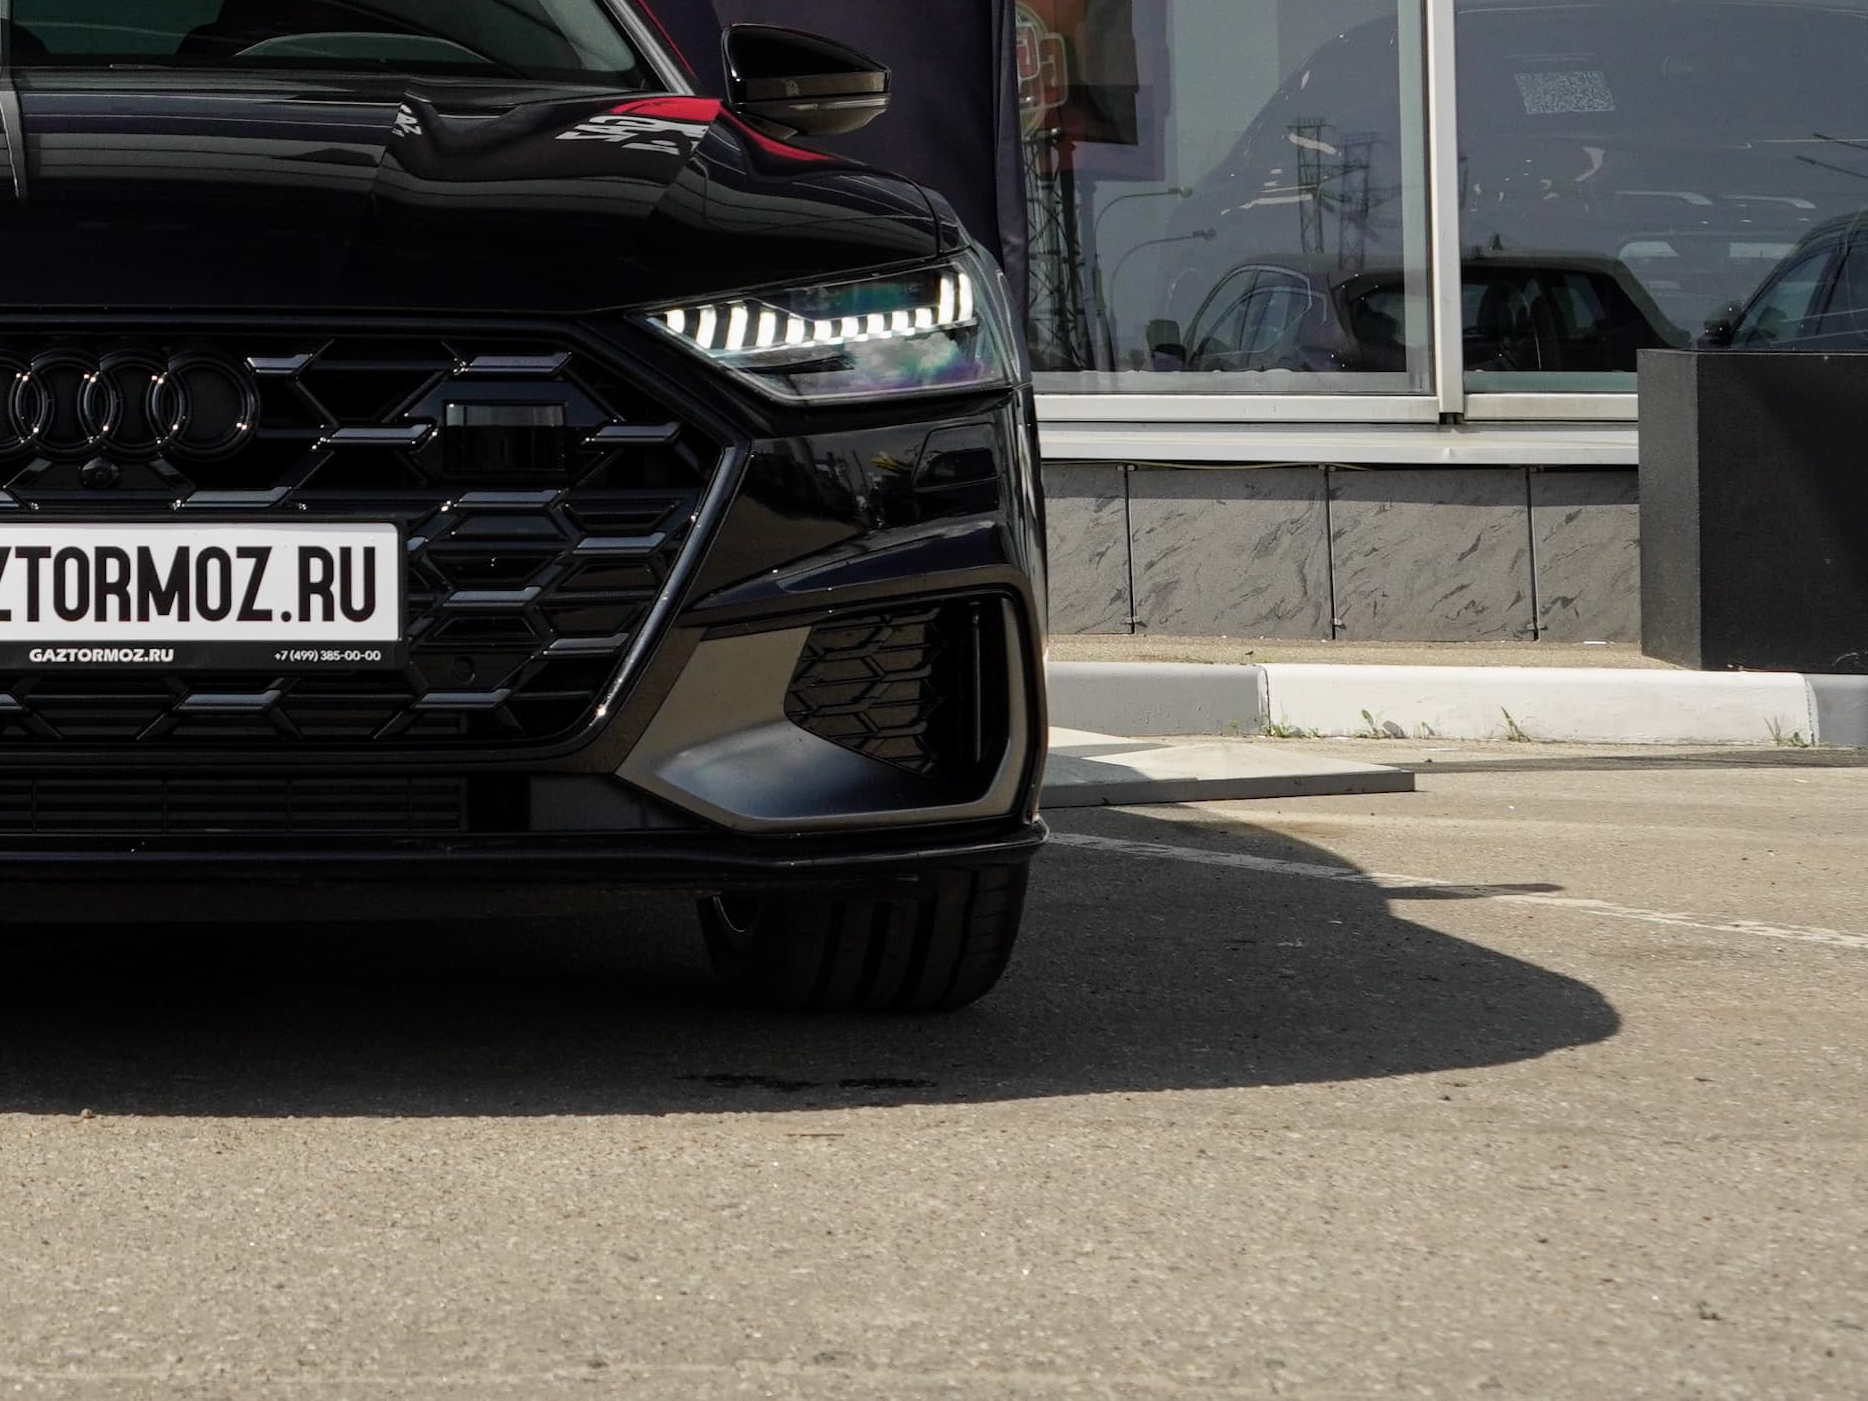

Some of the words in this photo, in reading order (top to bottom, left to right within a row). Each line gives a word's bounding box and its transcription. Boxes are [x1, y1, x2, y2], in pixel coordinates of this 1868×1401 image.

[29, 648, 175, 662] GAZTORMOZ.RU
[274, 650, 288, 661] +7
[289, 649, 319, 662] (499)
[320, 650, 381, 661] 385-00-00
